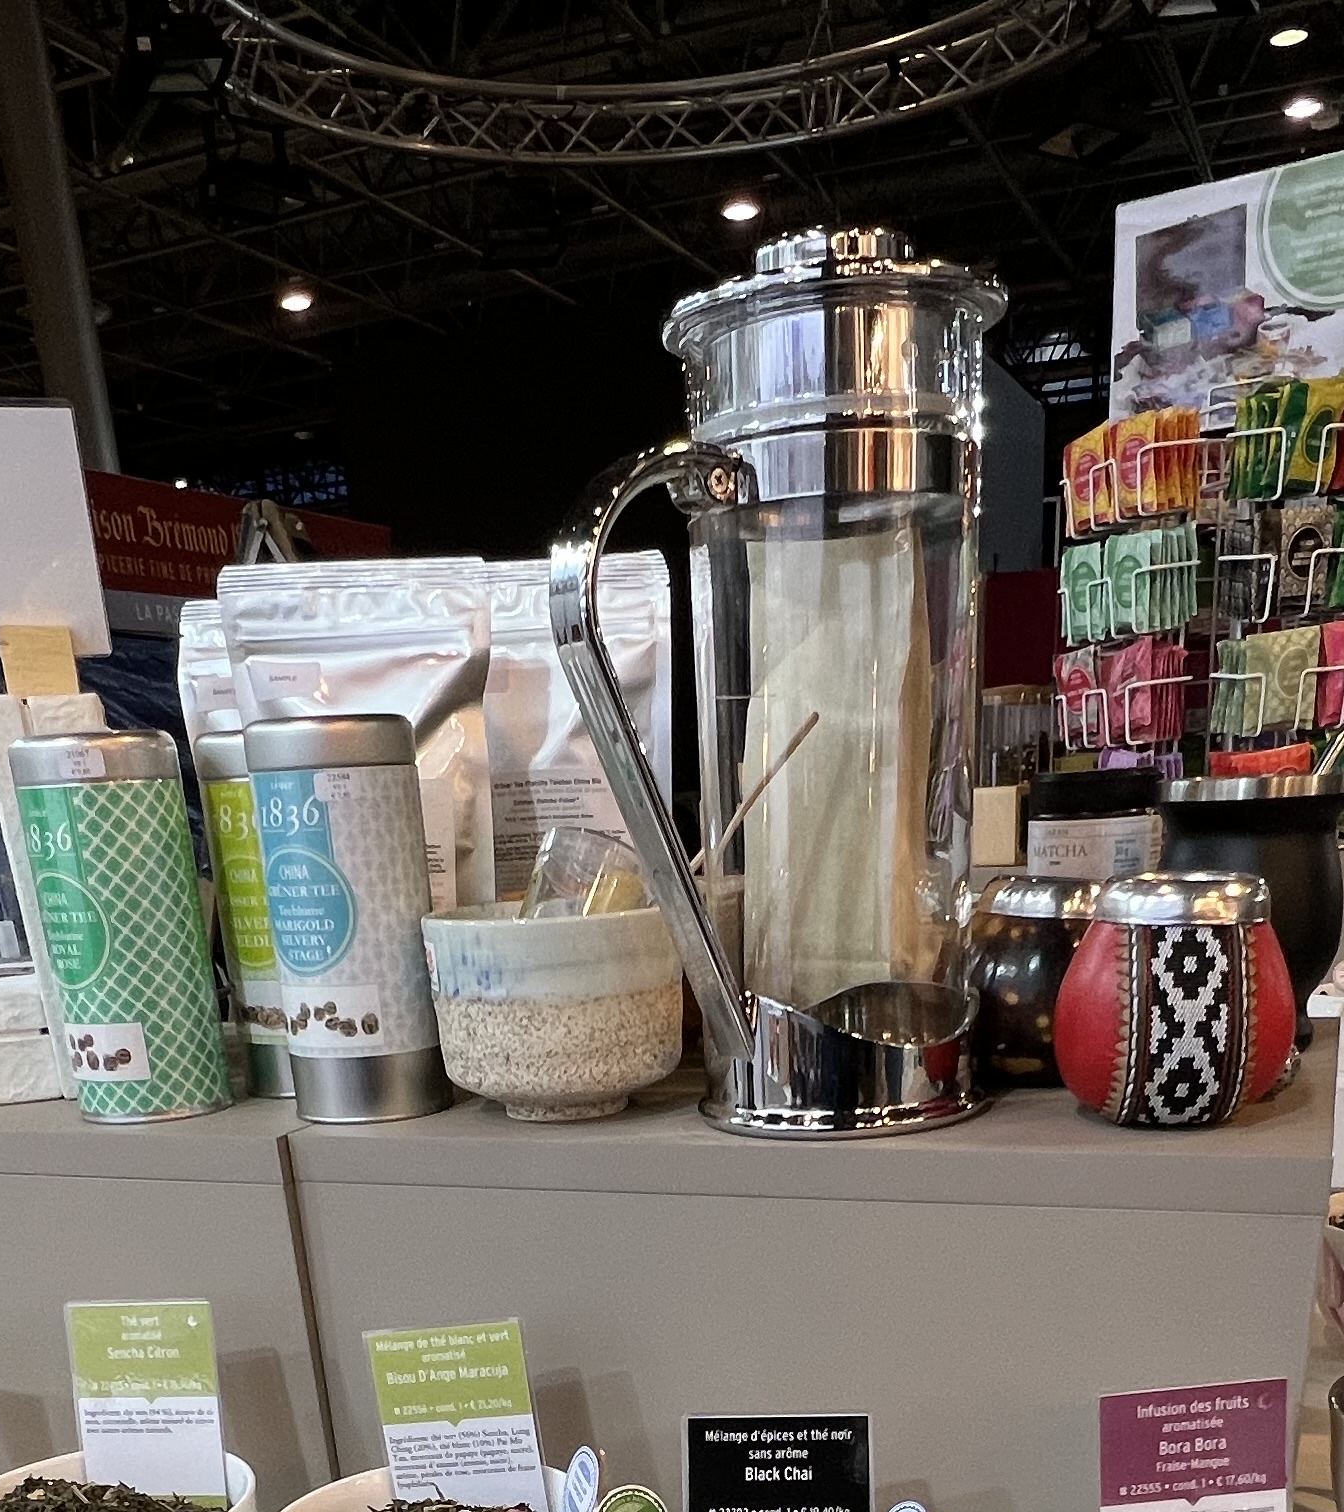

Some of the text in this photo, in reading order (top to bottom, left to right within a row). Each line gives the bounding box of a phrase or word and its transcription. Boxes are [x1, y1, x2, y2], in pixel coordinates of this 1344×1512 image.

[261, 794, 320, 837] 1836
[416, 1338, 428, 1349] de
[430, 1335, 447, 1346] thé
[489, 1329, 510, 1341] vert
[107, 1346, 180, 1359] Sencha Citron
[386, 1371, 417, 1385] Bisou
[459, 1364, 509, 1380] Maracuja
[1137, 1395, 1249, 1418] Infusion des fruits
[1162, 1416, 1224, 1433] aromatisée
[705, 1428, 852, 1444] Mélange d'épices et thé noir
[748, 1447, 809, 1460] sans arôme
[1159, 1437, 1227, 1456] Bora Bora
[745, 1465, 813, 1481] Black Chai
